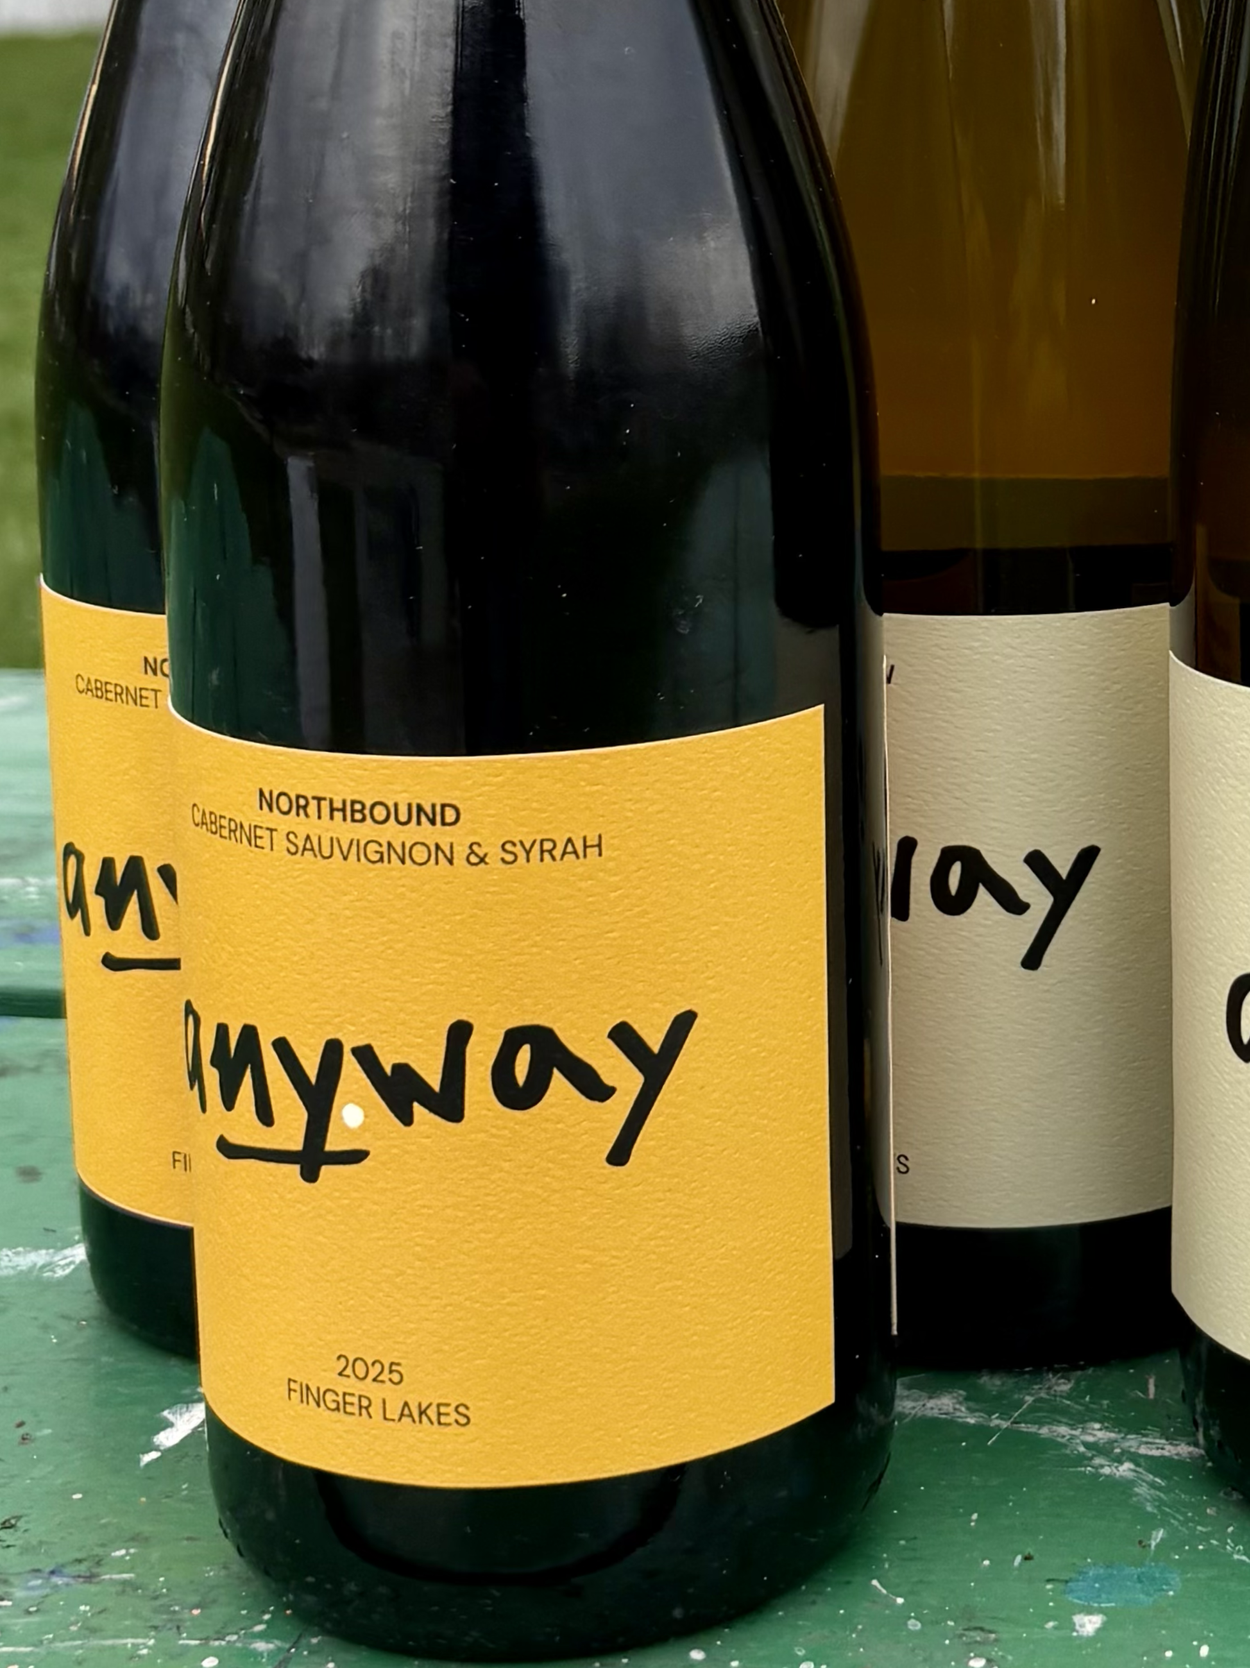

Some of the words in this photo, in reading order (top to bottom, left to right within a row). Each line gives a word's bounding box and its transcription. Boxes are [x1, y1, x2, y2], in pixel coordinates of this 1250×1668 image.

[75, 673, 162, 709] CABERNET
[258, 787, 461, 827] NORTHBOUND
[191, 803, 278, 851] CABERNET
[285, 830, 455, 867] SAUVIGNON
[465, 841, 490, 867] &
[500, 833, 603, 865] SYRAH
[336, 1353, 404, 1386] 2025
[287, 1378, 373, 1419] FINGER
[382, 1397, 471, 1428] LAKES
